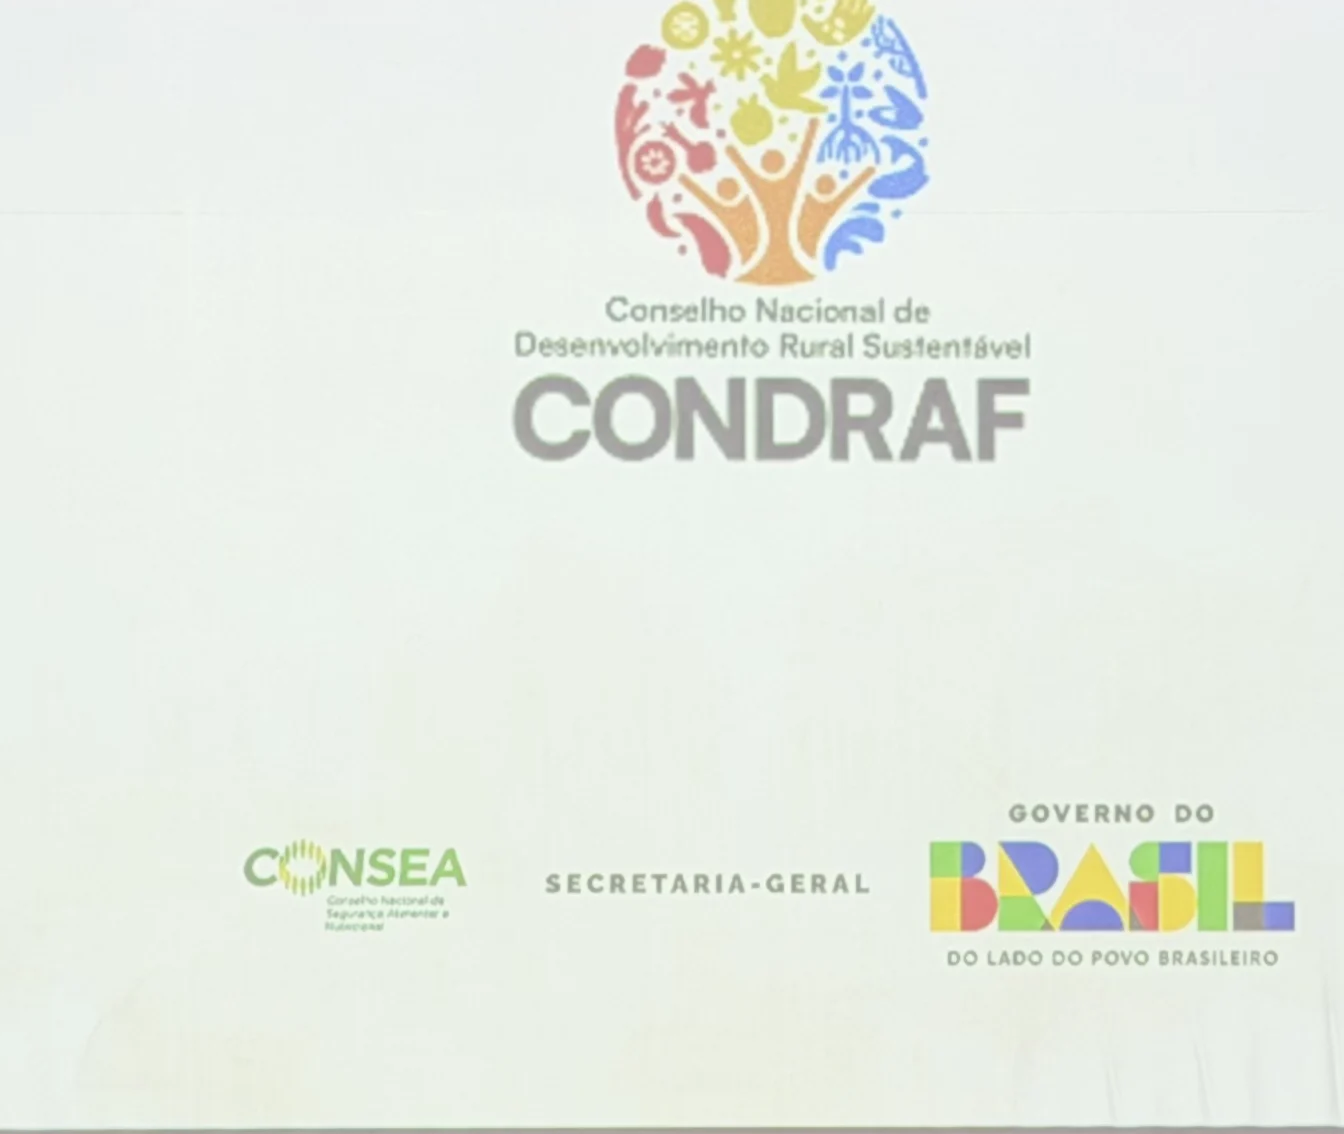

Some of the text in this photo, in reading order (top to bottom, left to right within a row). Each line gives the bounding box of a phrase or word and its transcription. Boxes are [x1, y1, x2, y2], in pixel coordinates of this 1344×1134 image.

[605, 297, 931, 324] Conselho Nacional de
[514, 331, 1031, 359] Desenvolvimento Rural Sustentável
[513, 374, 1031, 462] CONDRAF
[1008, 804, 1215, 824] GOVERNO DO
[243, 839, 468, 897] CONSEA
[545, 872, 871, 895] SECRETARIA-GERAL
[929, 841, 1295, 932] BRASIL
[947, 950, 1279, 967] DO LADO DO POVO BRASILEIRO
